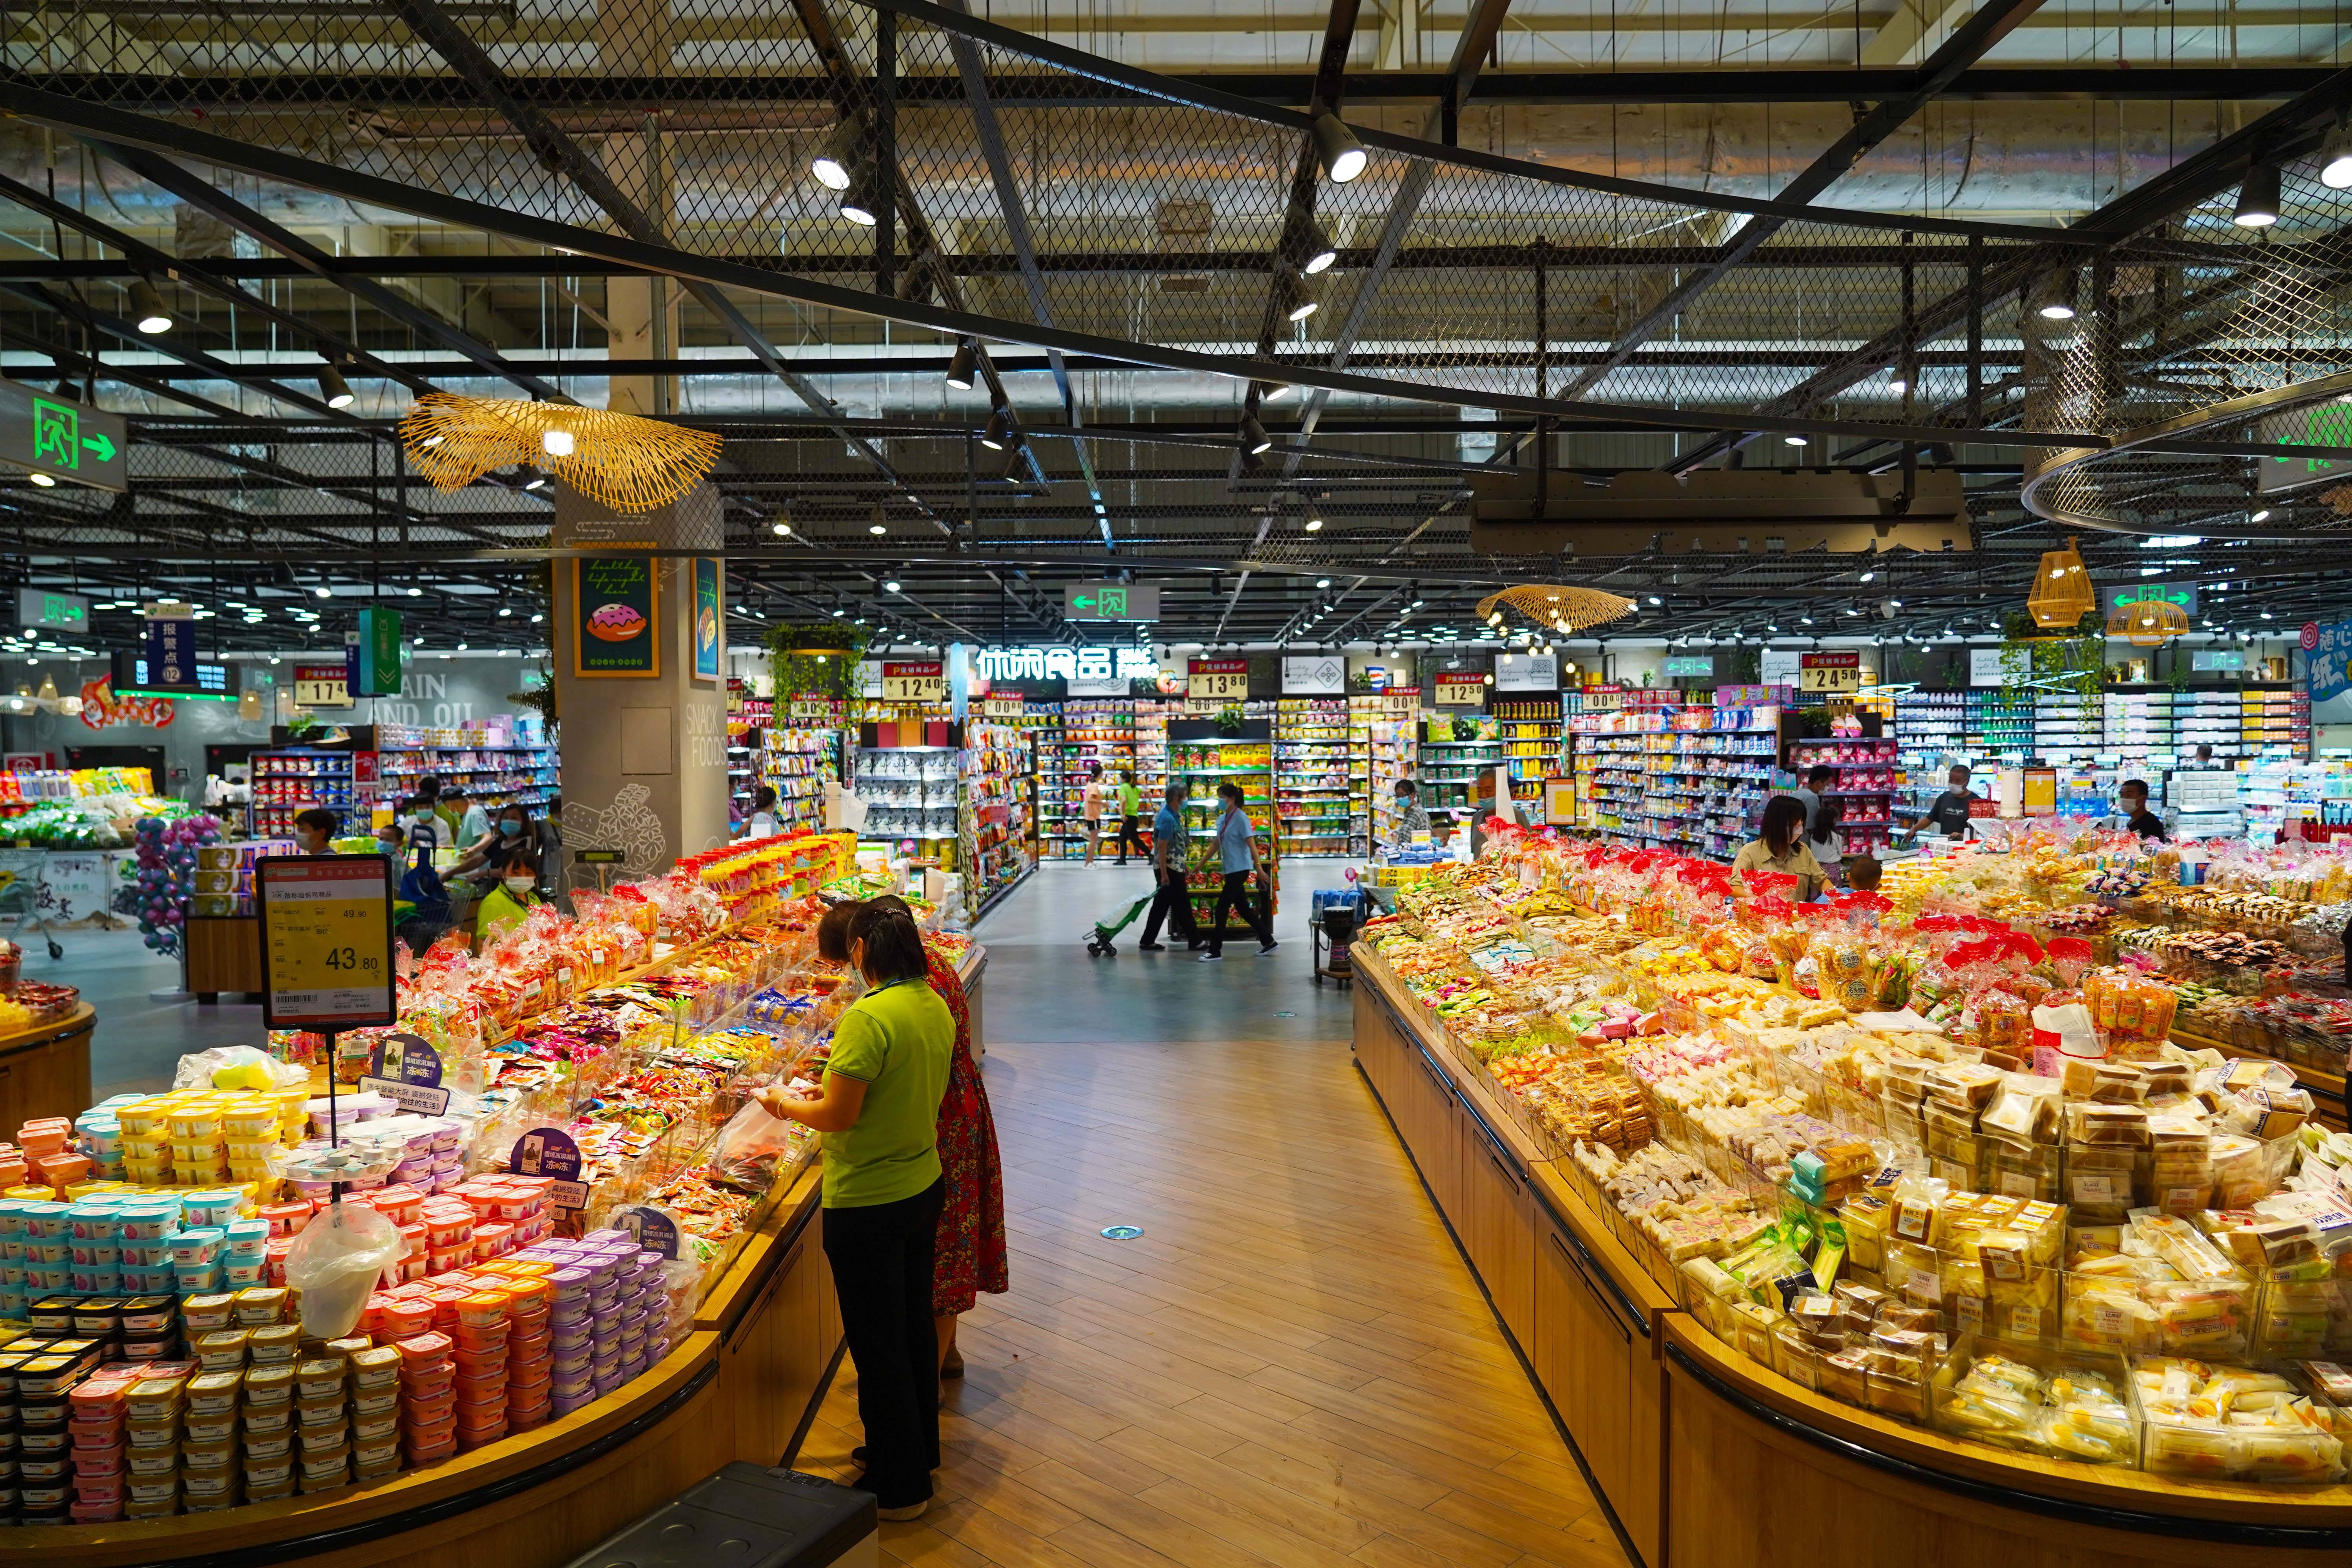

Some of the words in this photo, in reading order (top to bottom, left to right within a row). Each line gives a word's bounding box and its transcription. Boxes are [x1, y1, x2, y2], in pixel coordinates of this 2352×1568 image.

[165, 669, 178, 679] 02
[976, 648, 1112, 681] 休闲食品
[392, 674, 446, 699] AIN
[686, 704, 719, 735] SNACK
[692, 737, 727, 767] FOODS
[326, 947, 377, 970] 43.80
[412, 1091, 439, 1102] 震撼登陆
